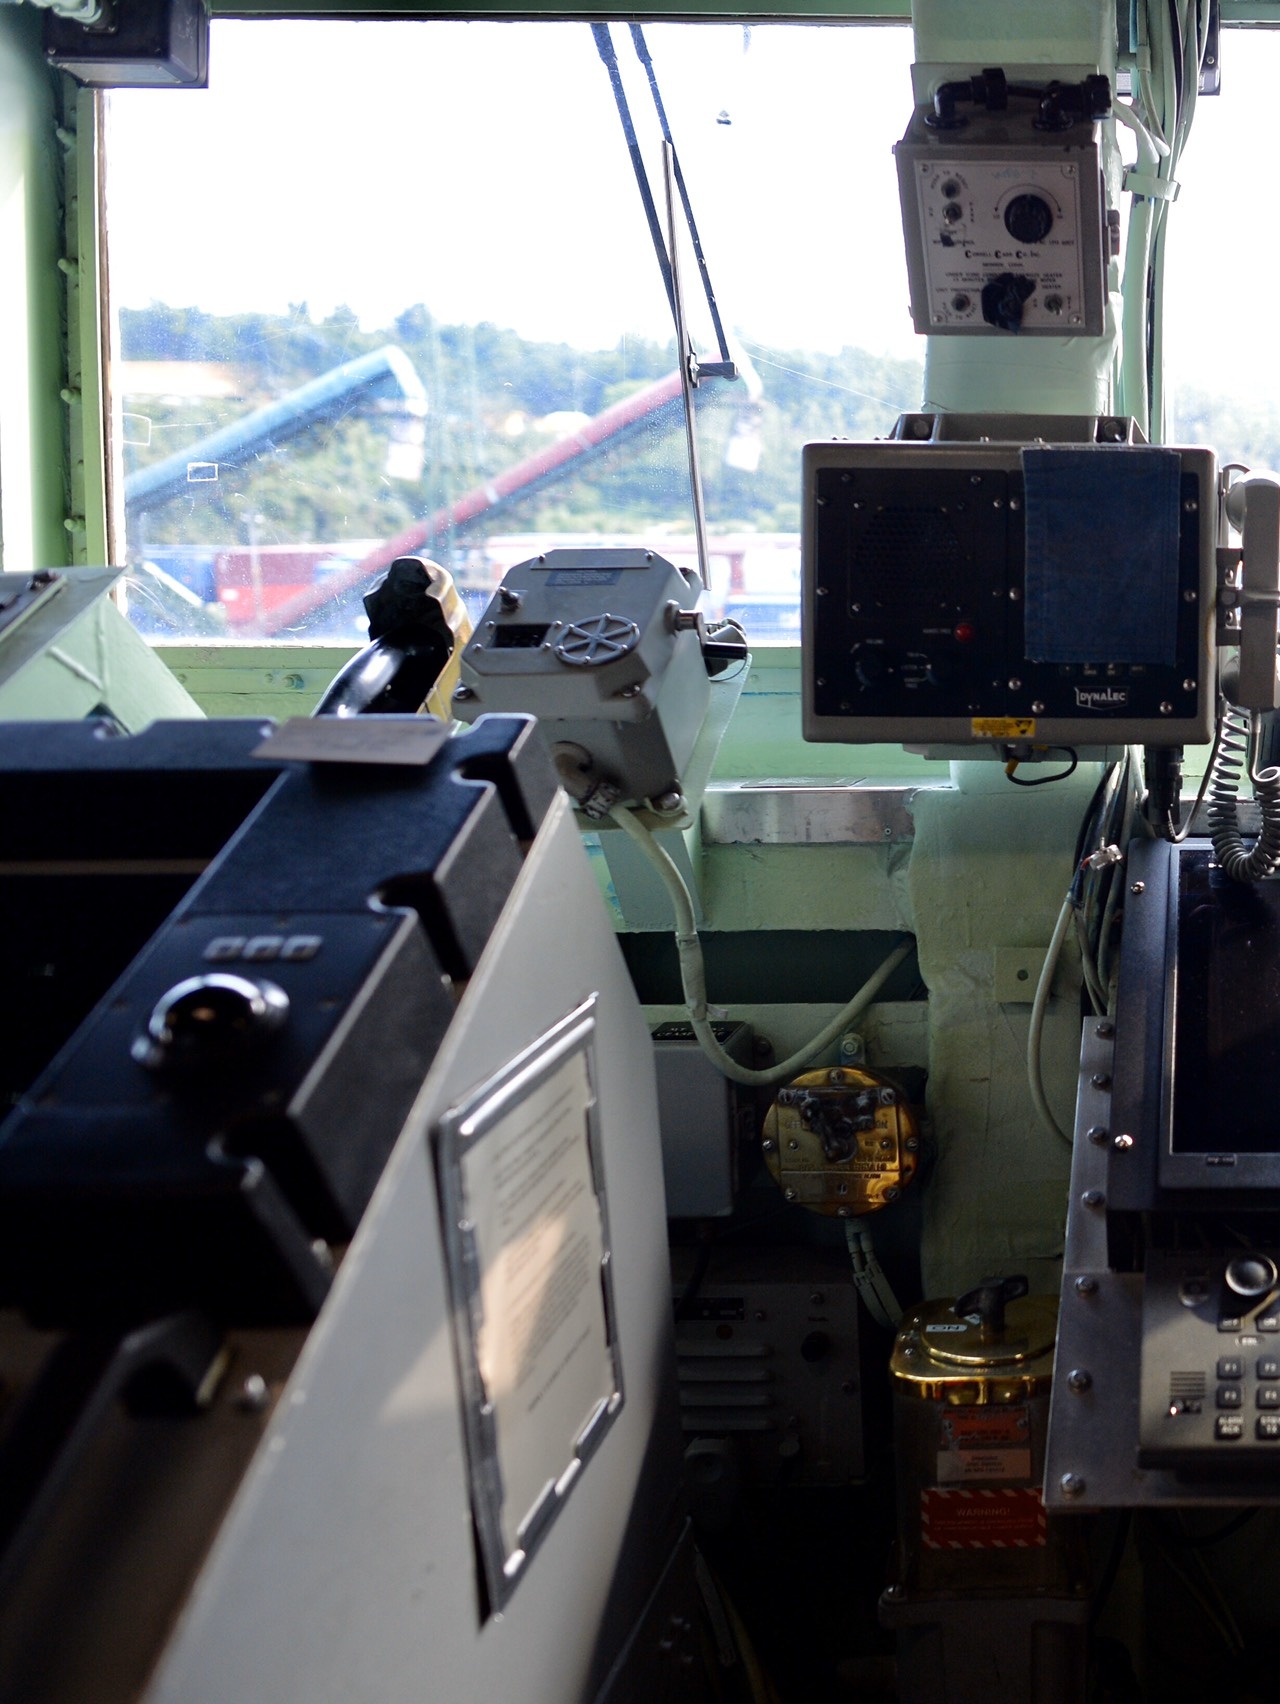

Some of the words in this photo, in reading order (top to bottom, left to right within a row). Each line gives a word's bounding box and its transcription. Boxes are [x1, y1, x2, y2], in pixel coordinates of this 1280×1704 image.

[1080, 688, 1126, 705] DYNALEC
[932, 1324, 960, 1332] ON
[956, 1507, 1011, 1518] WARNING!
